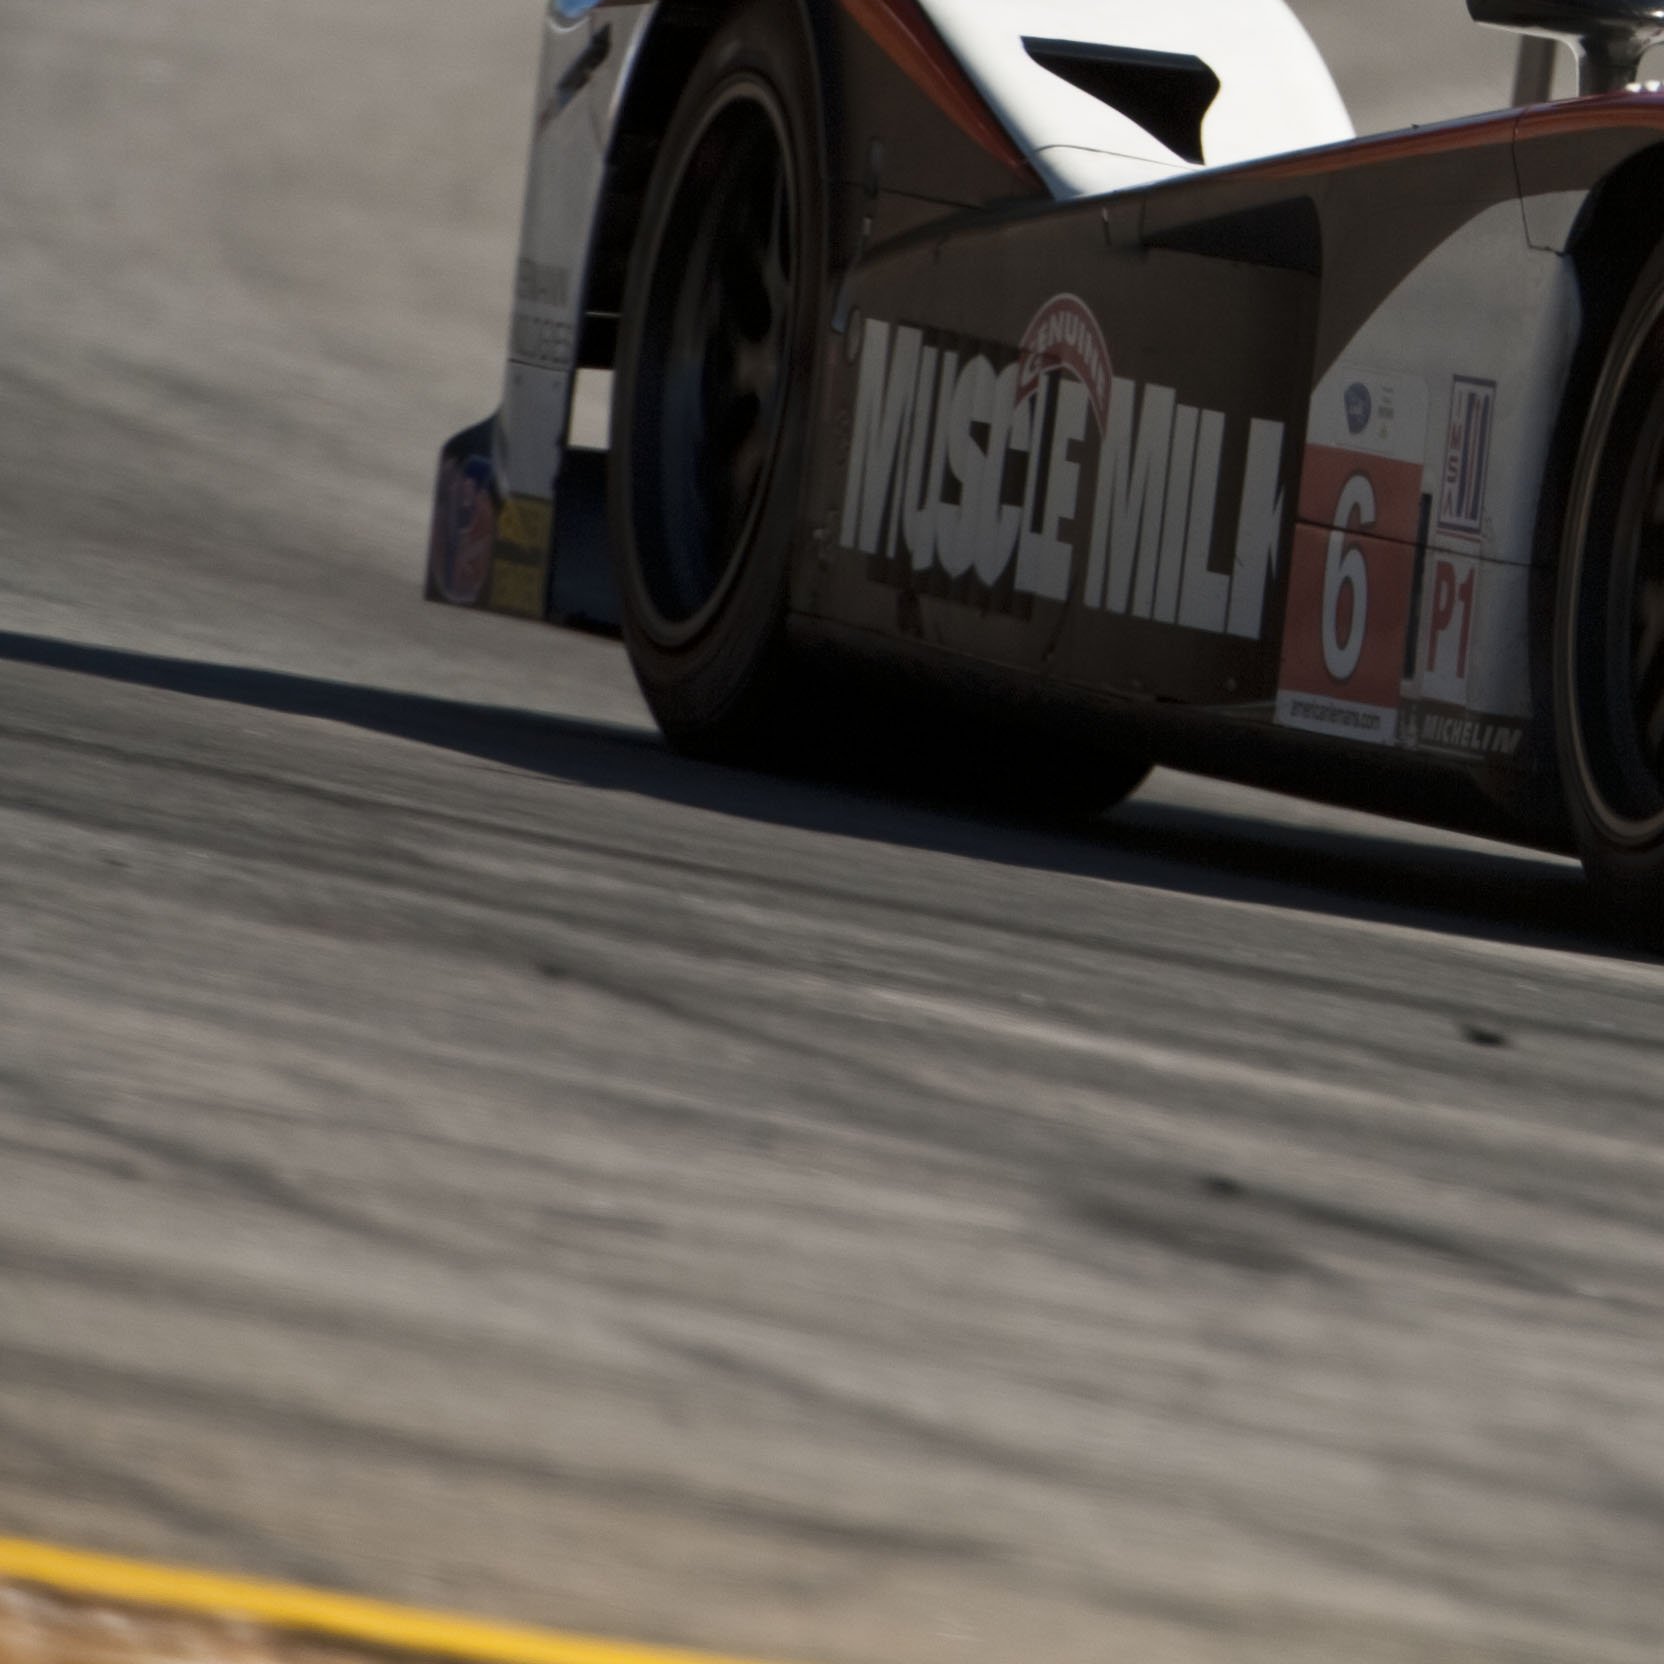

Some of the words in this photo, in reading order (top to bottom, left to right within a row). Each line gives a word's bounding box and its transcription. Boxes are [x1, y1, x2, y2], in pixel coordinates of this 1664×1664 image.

[840, 318, 1090, 602] MUSCLE
[1321, 474, 1376, 681] 6
[1427, 560, 1475, 679] P1
[1422, 713, 1524, 754] MICHELIN
